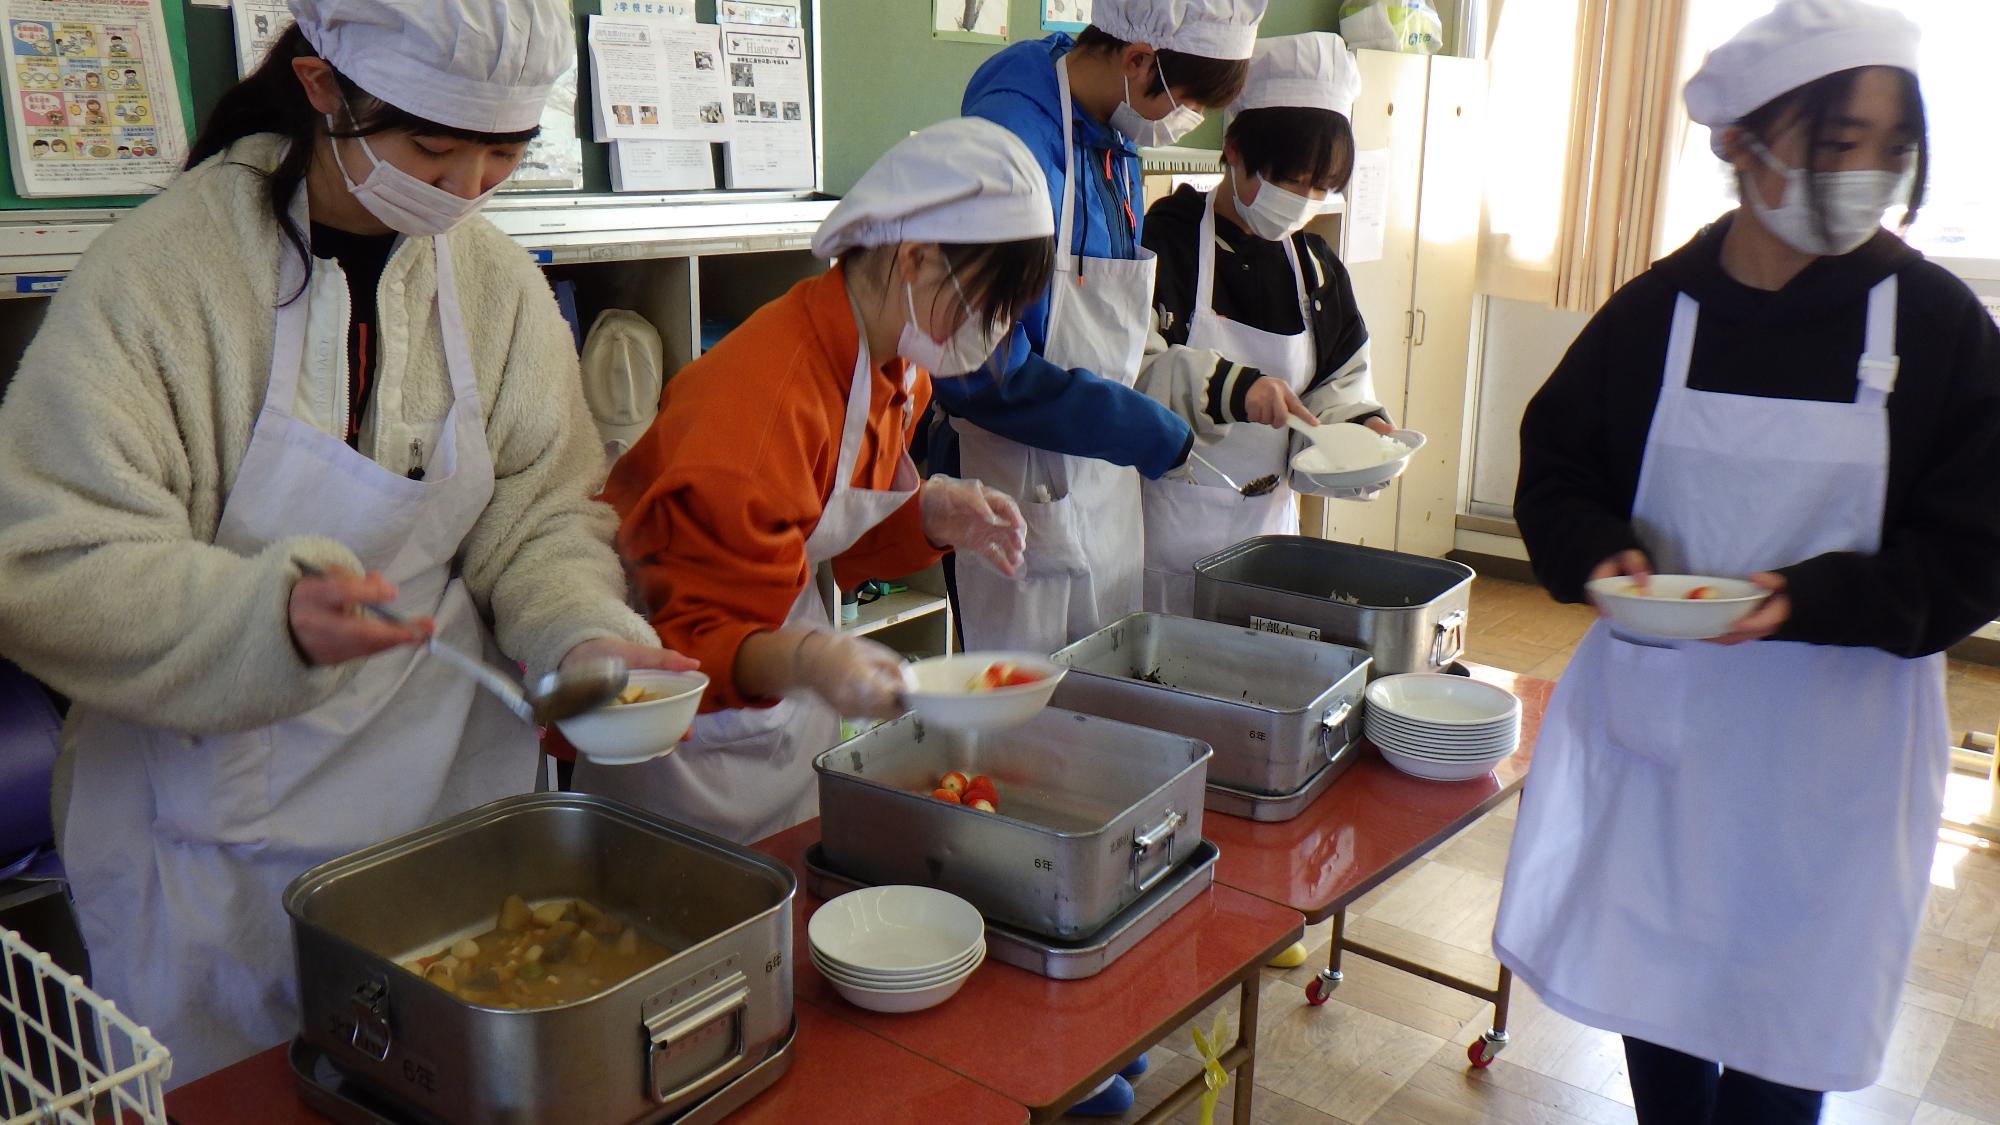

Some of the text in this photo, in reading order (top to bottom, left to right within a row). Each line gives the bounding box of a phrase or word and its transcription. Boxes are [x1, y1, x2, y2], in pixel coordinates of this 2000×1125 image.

[746, 41, 779, 55] History
[1249, 730, 1266, 741] 6年
[1034, 858, 1053, 872] 6年
[765, 952, 782, 973] 6年
[403, 1058, 438, 1095] 6年
